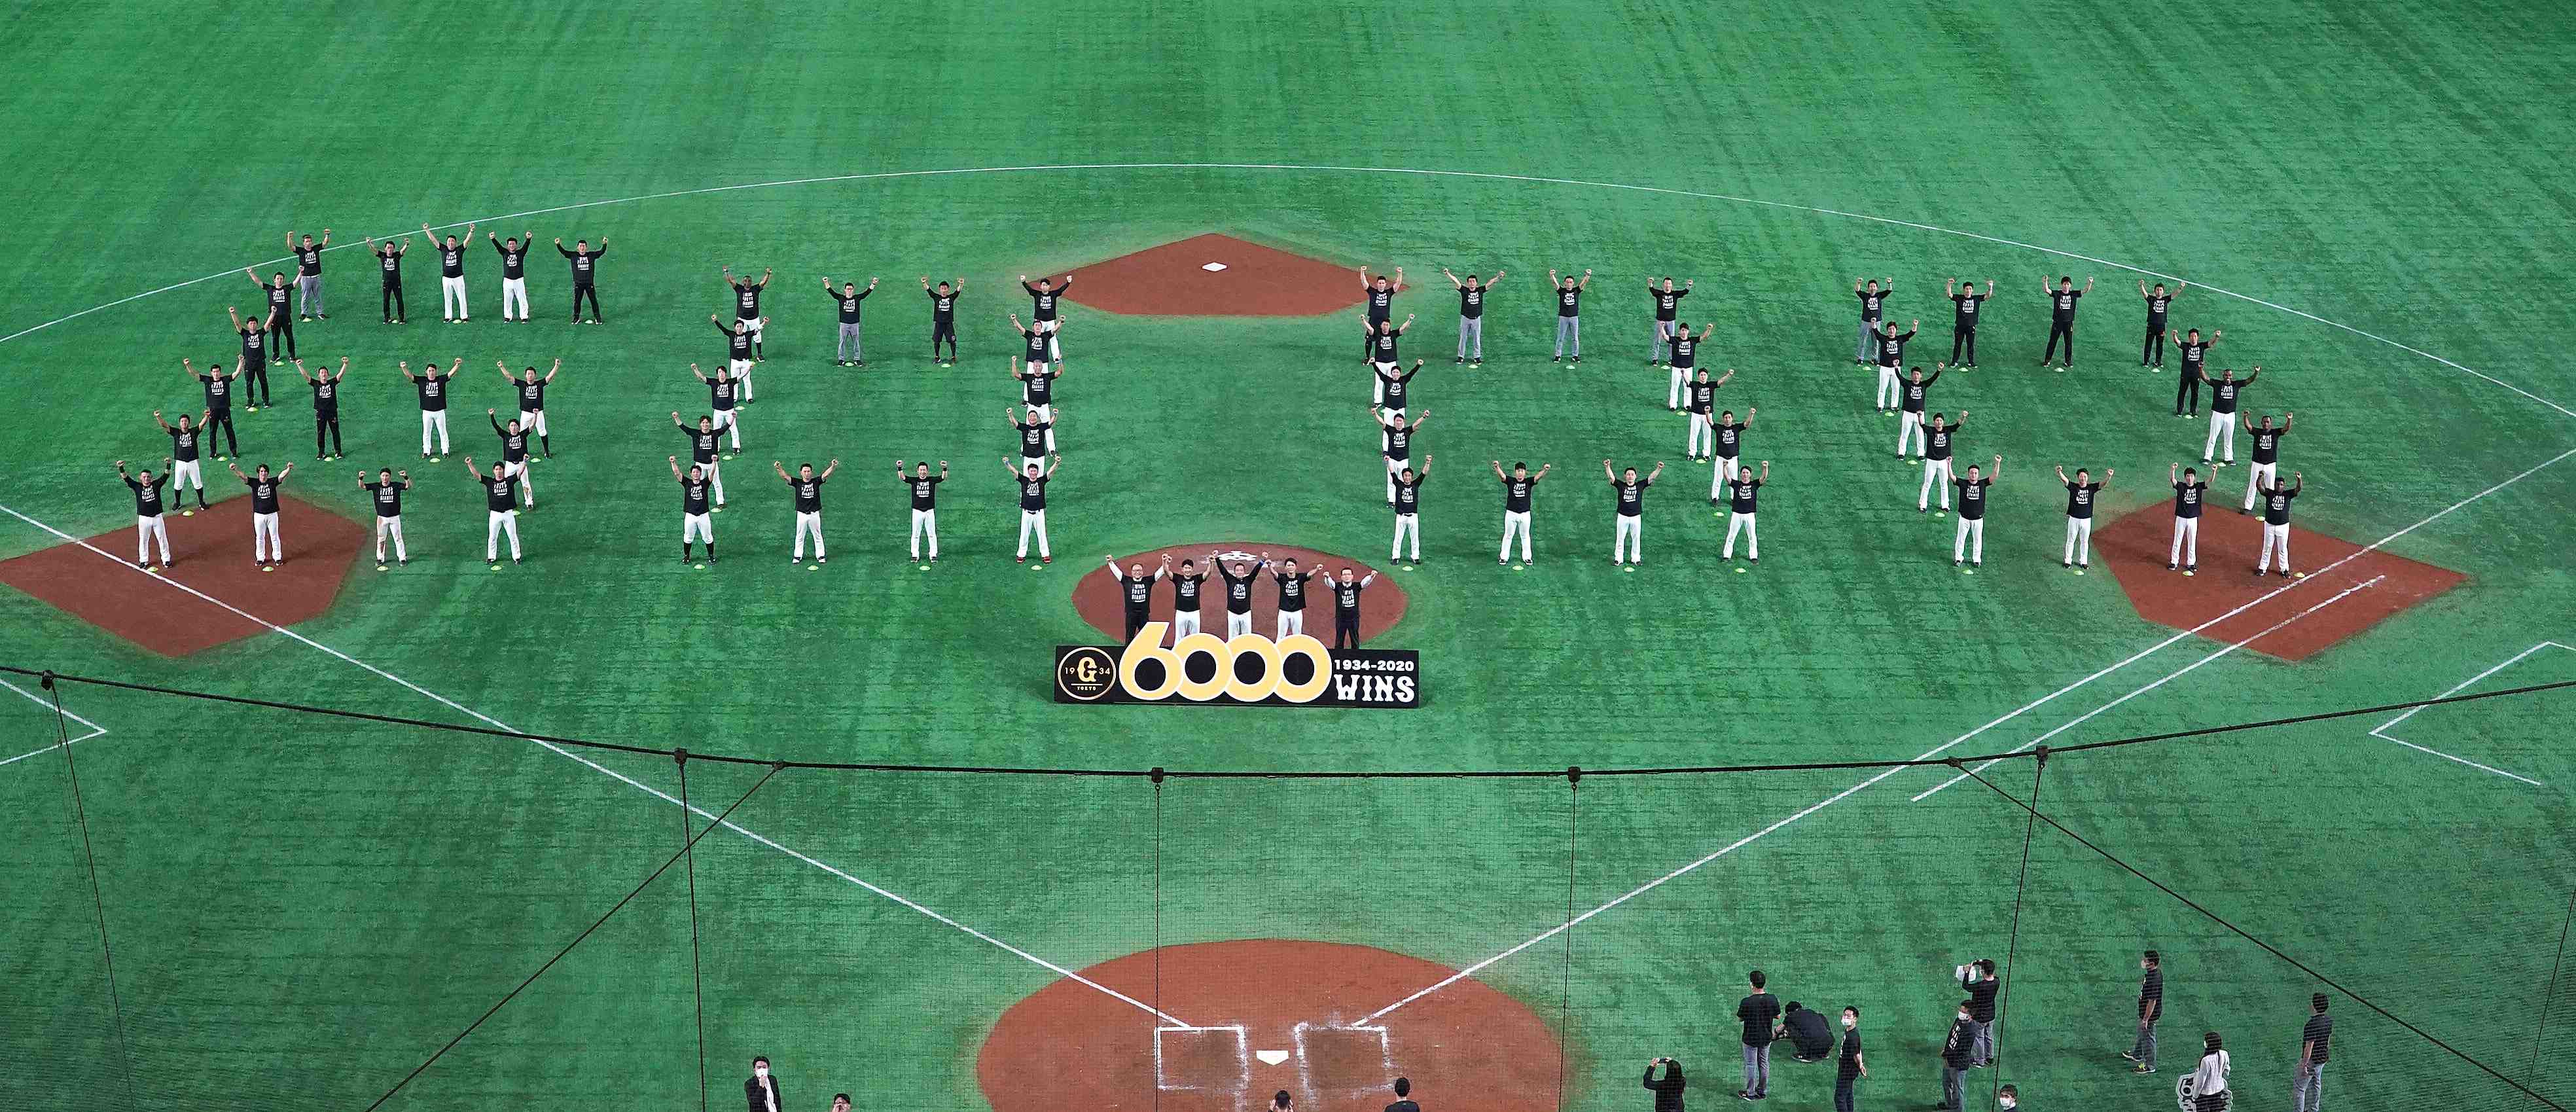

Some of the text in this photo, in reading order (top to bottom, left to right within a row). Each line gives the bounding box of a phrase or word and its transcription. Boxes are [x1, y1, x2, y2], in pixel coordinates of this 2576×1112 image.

[1077, 656, 1098, 682] G
[1118, 621, 1333, 703] 6000
[1334, 659, 1414, 672] 1934-2020
[1333, 673, 1415, 703] WINS
